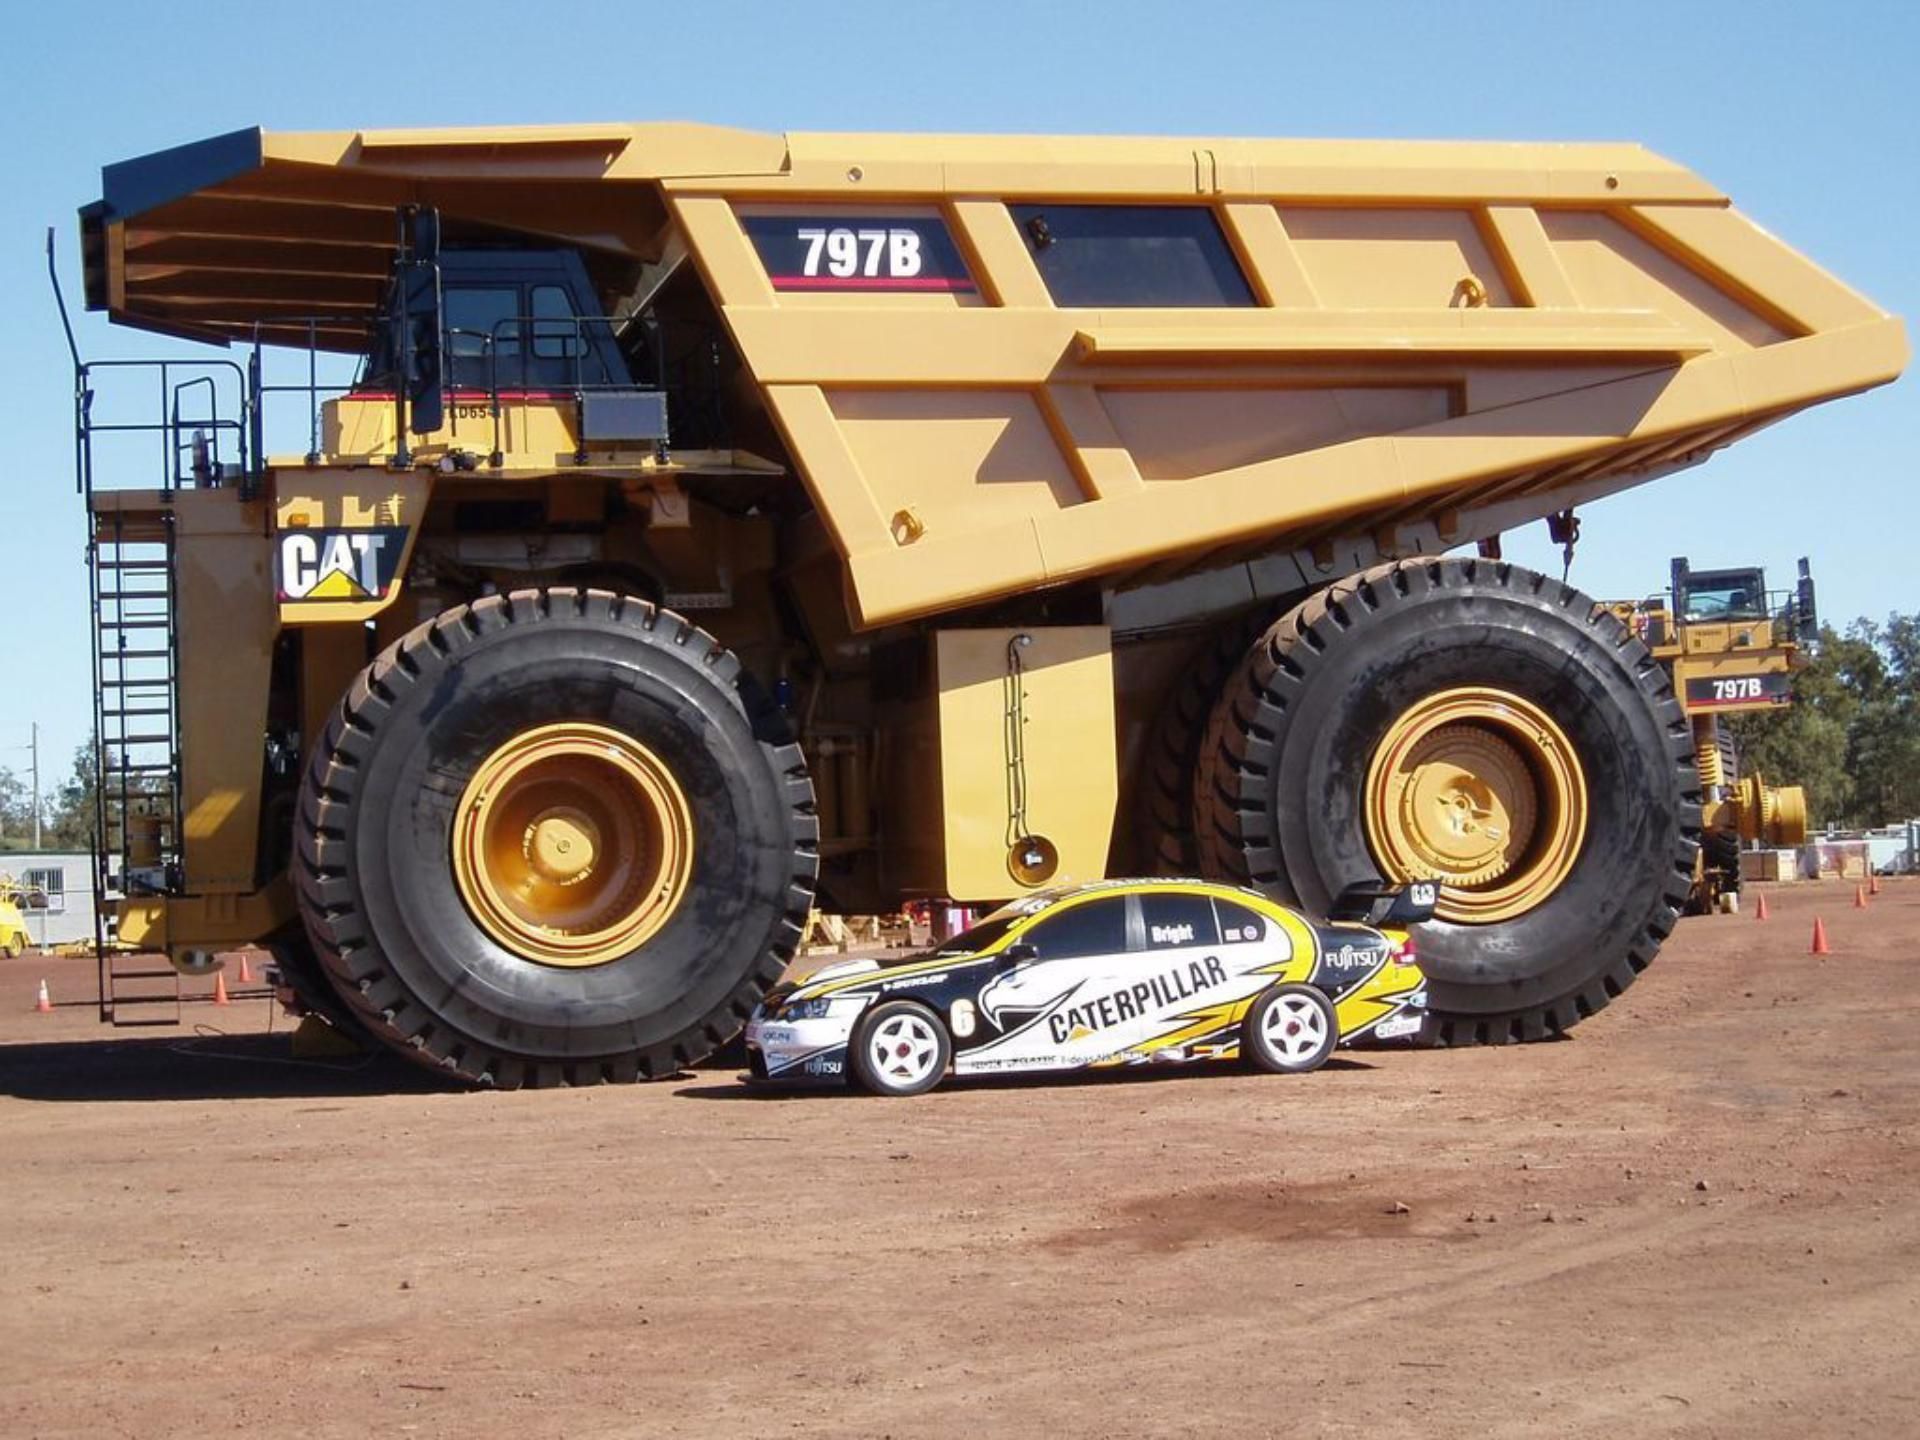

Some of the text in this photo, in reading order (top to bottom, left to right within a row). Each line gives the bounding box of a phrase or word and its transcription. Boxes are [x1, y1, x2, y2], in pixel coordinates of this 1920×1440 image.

[797, 227, 922, 278] 797B
[281, 533, 387, 599] CAT
[1712, 678, 1762, 700] 797B
[1150, 923, 1195, 944] Bright
[1325, 944, 1377, 971] FUJITSU
[1048, 955, 1228, 1045] CATERPILLAR
[950, 998, 976, 1038] 6
[804, 1056, 843, 1076] FUJITSU
